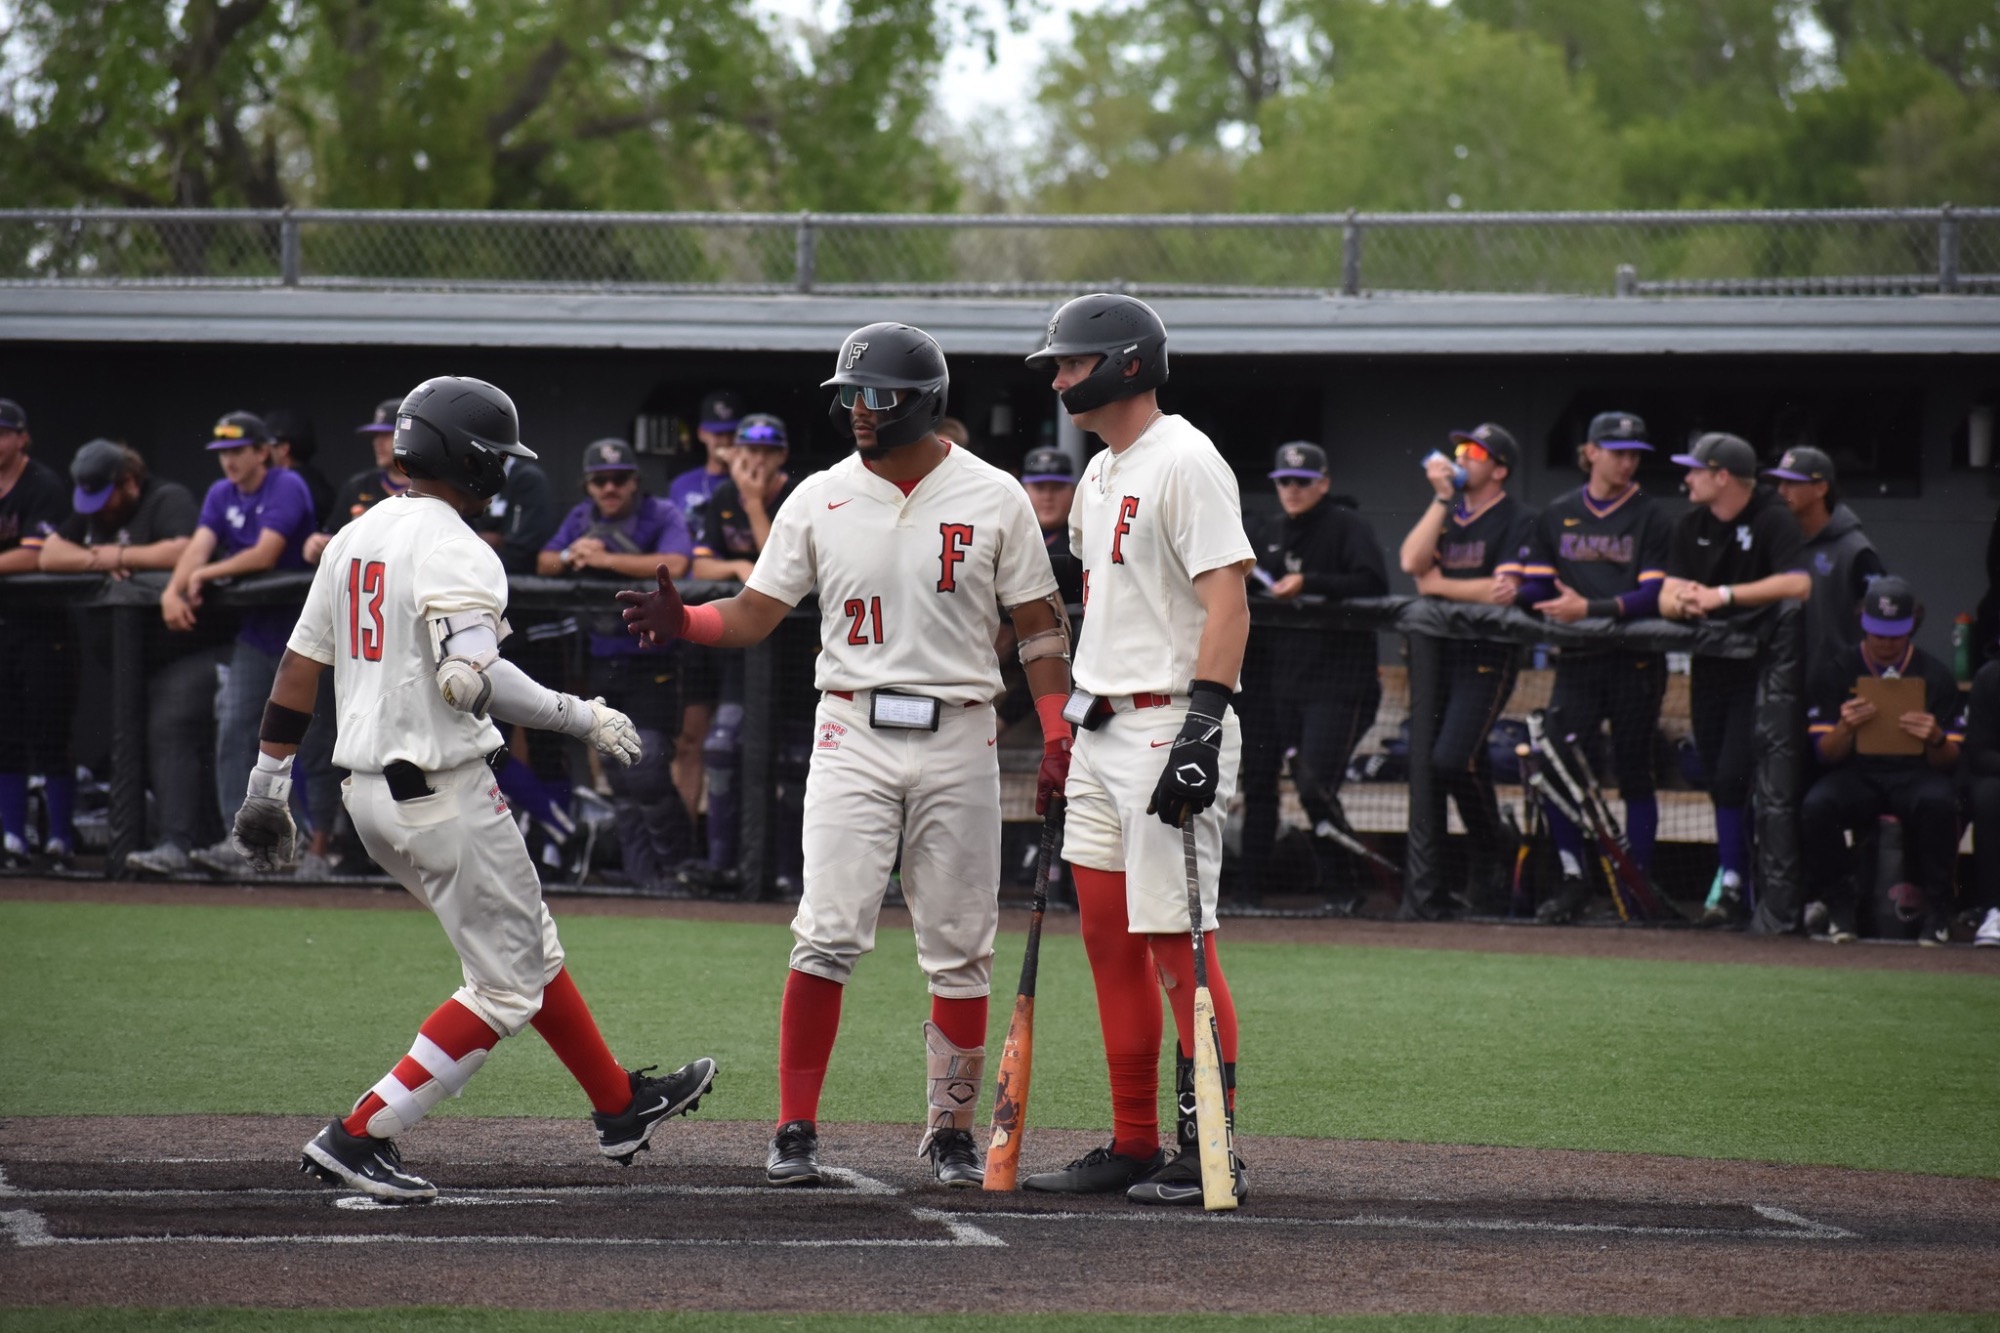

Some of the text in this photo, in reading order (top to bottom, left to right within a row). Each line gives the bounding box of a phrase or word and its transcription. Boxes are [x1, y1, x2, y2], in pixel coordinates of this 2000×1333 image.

[845, 342, 869, 369] F
[936, 522, 974, 593] F
[1111, 495, 1140, 565] F
[348, 558, 386, 662] 13
[844, 596, 884, 646] 21
